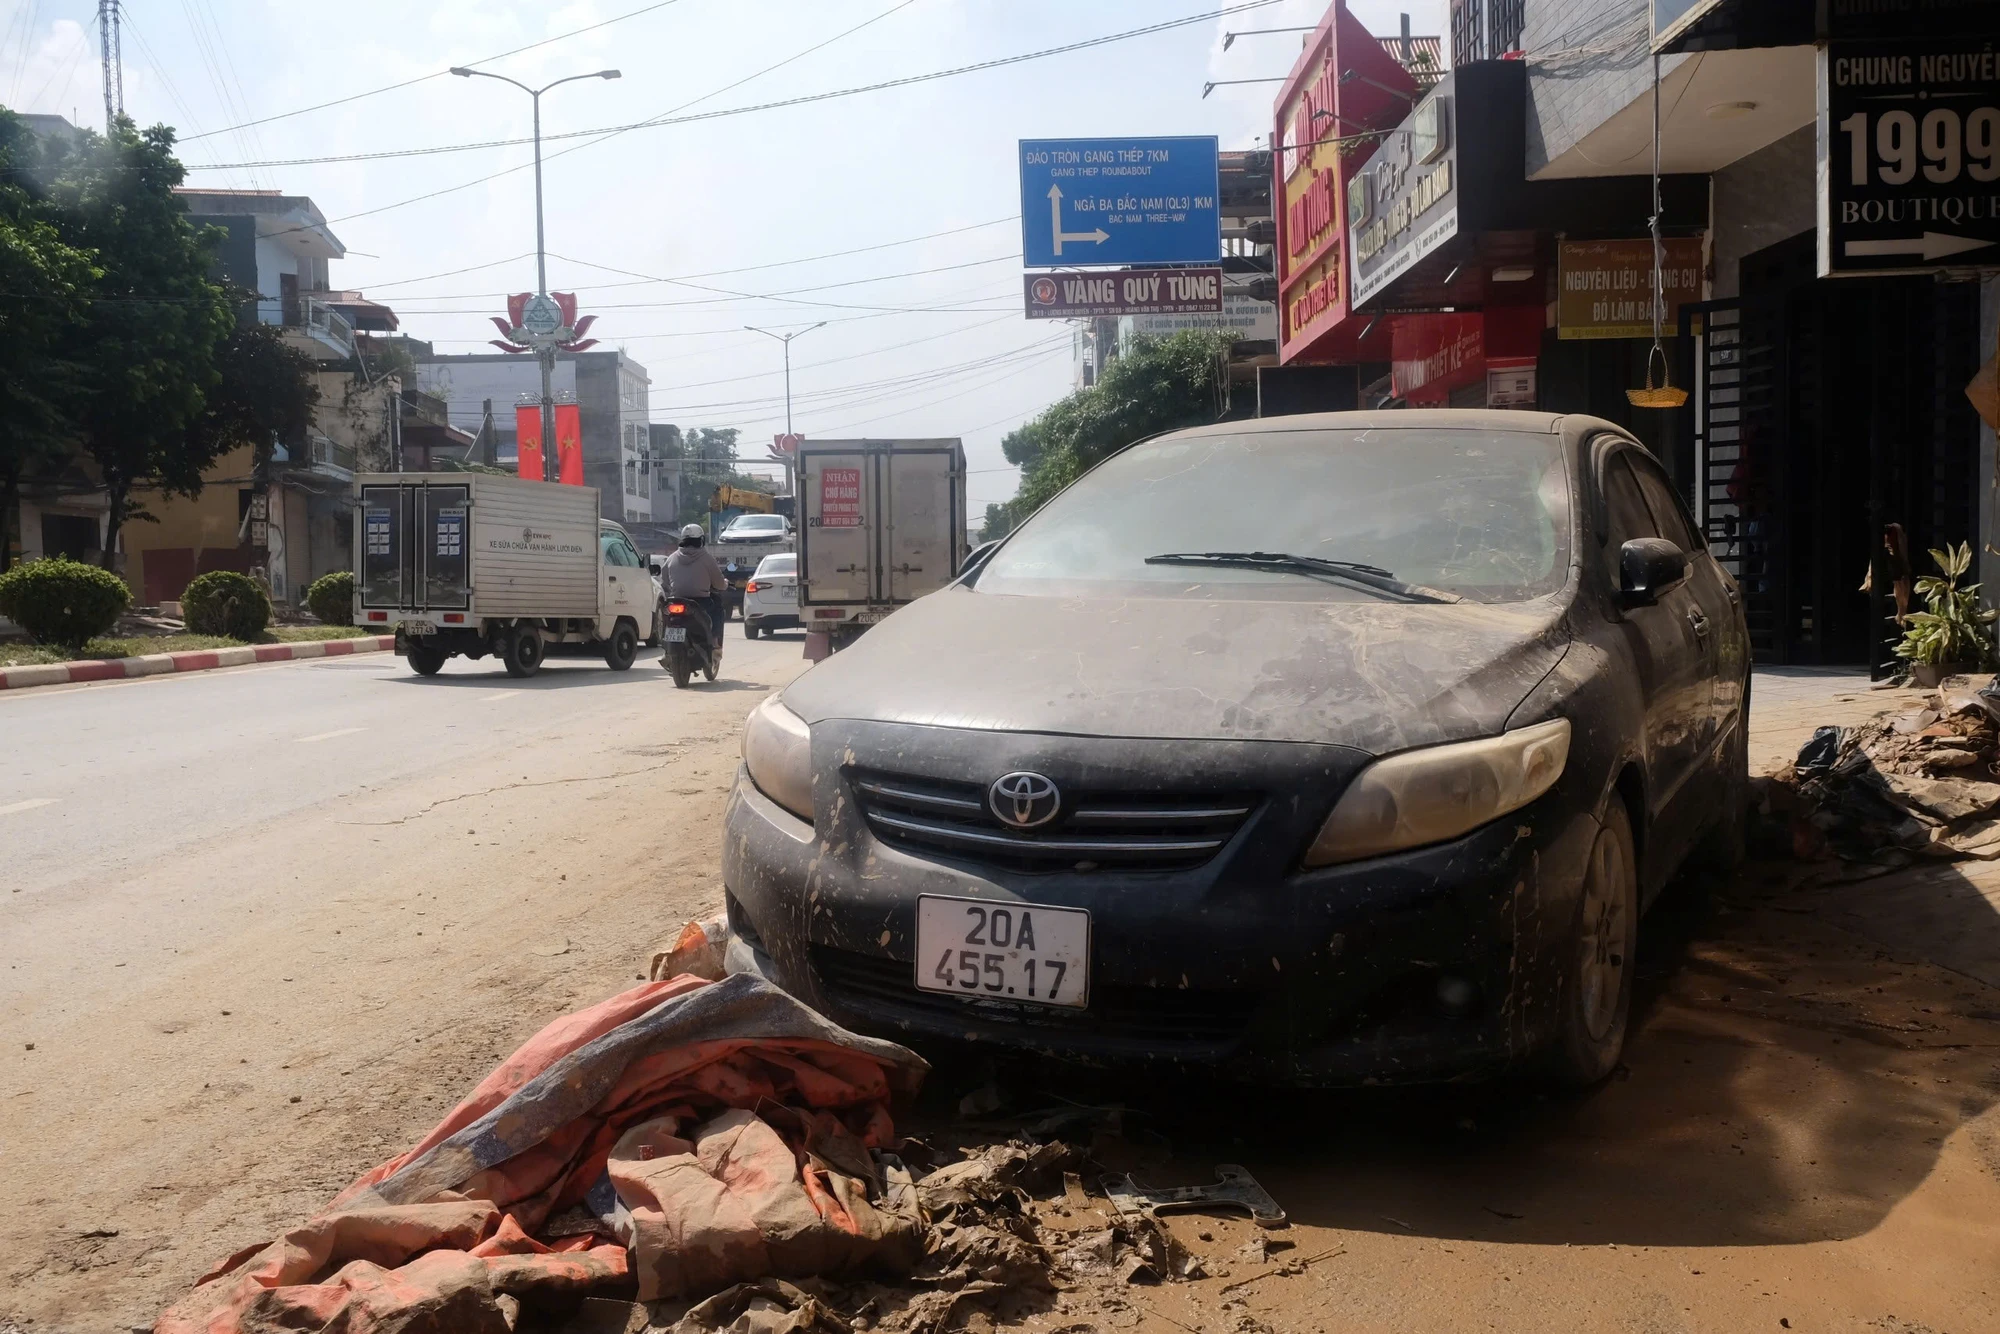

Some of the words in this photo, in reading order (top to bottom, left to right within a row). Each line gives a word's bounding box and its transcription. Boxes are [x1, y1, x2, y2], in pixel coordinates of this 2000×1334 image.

[1836, 55, 1911, 86] CHUNG
[1026, 148, 1048, 164] ĐẢO
[1052, 148, 1079, 164] TRÒN
[1084, 150, 1114, 163] GANG
[1118, 147, 1143, 163] THÉP
[1147, 150, 1169, 162] 7KM
[1840, 107, 2000, 186] 1999
[1051, 168, 1075, 177] GANG
[1078, 168, 1099, 176] THEP
[1102, 166, 1152, 176] ROUNDABOUT
[1074, 196, 1095, 211] NGÃ
[1100, 199, 1113, 211] BA
[1117, 192, 1137, 210] BẮC
[1141, 198, 1163, 210] NAM
[1165, 196, 1190, 210] (QL3)
[1194, 197, 1213, 209] 1KM
[1109, 215, 1123, 223] BAC
[1126, 214, 1142, 223] NAM
[1146, 213, 1186, 222] THREE-WAY
[1063, 275, 1115, 304] VÀNG
[1123, 272, 1161, 305] QUÝ
[1167, 271, 1217, 301] TÙNG
[1565, 266, 1610, 291] NGUYÊN
[1614, 266, 1637, 294] LIỆU
[1648, 269, 1679, 289] DNG
[1682, 269, 1697, 292] CỤ
[1611, 298, 1635, 321] LÀM
[840, 485, 857, 499] HÀNG
[489, 540, 497, 548] XE
[965, 906, 1036, 951] 20A
[935, 948, 1067, 999] 455.17
